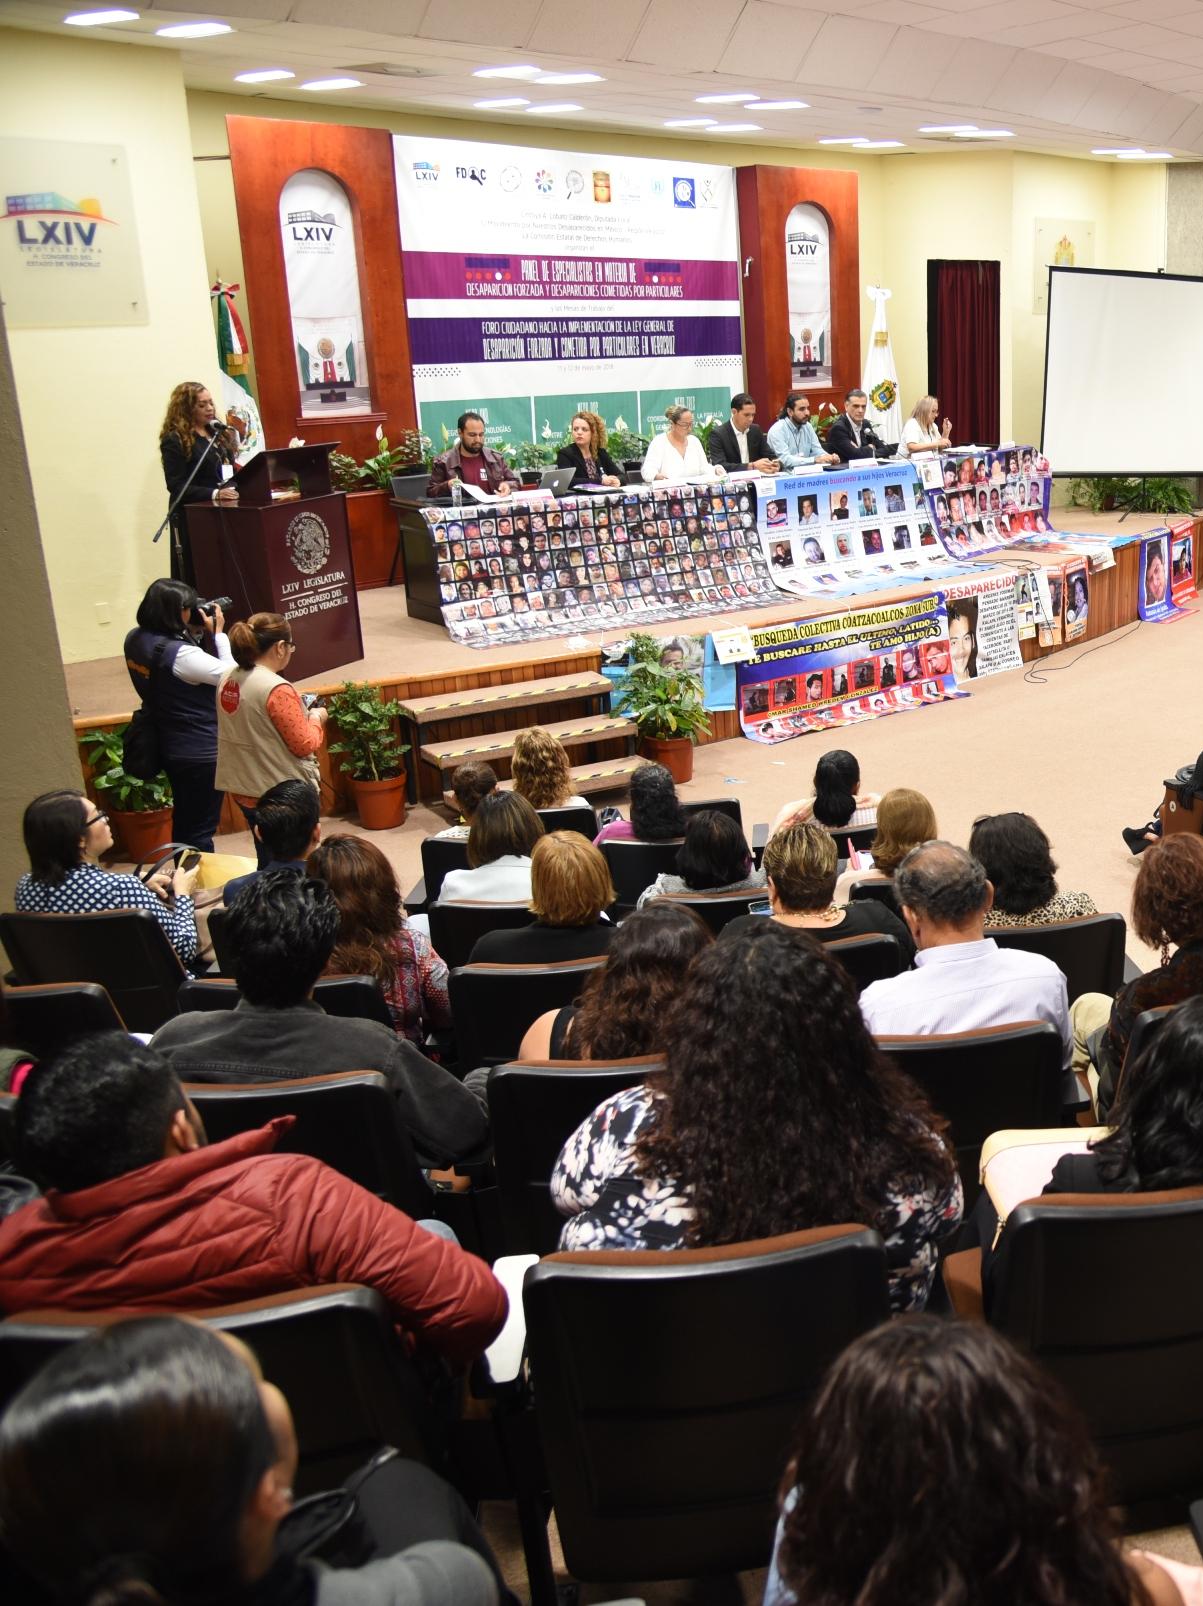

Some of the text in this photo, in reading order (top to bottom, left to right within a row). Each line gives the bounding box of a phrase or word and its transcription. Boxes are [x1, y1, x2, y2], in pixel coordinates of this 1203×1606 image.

[415, 172, 439, 181] LXIV
[16, 219, 98, 246] LXIV
[292, 227, 333, 241] LXIV
[790, 244, 817, 256] LXIV
[521, 260, 637, 283] PANEL DE ESPECIALISTAS EN MATERIA DE
[514, 283, 544, 297] FORZADA
[545, 284, 550, 297] Y
[551, 284, 599, 297] DESAPARICIONES
[600, 285, 632, 297] COMETIDAS
[633, 285, 645, 298] POR
[645, 285, 683, 298] PARTICULARES
[481, 321, 500, 335] FORO
[501, 321, 538, 335] CIUDADANO
[539, 321, 559, 334] HACIA
[559, 321, 568, 334] LA
[615, 320, 623, 333] DE
[623, 320, 632, 332] LA
[632, 320, 642, 332] LEY
[642, 320, 666, 332] GENERAL
[667, 320, 674, 332] DE
[482, 334, 675, 360] DESAPARICIÓN FORZADA Y COMETIDA POR PARTICULARES EN VERACRUZ
[485, 425, 512, 434] NOLOGÍAS
[783, 481, 796, 490] Red
[797, 480, 805, 488] de
[806, 478, 829, 488] madres
[829, 475, 857, 485] buscando
[871, 471, 885, 481] hijos
[885, 469, 908, 479] Veracruz
[282, 571, 346, 594] LXIV LEGISLATURA
[284, 596, 349, 621] ESTADO DE VERACRUZ
[297, 591, 330, 608] CONGRESO
[331, 589, 343, 600] DEL
[799, 619, 841, 639] COLECTIVA
[842, 608, 904, 629] COATZACOALCOS
[905, 602, 922, 617] ZONA
[762, 644, 813, 663] BUSCARE
[813, 637, 846, 653] HASTA
[847, 634, 860, 645] EL
[869, 639, 884, 651] TE
[883, 636, 904, 648] AMO
